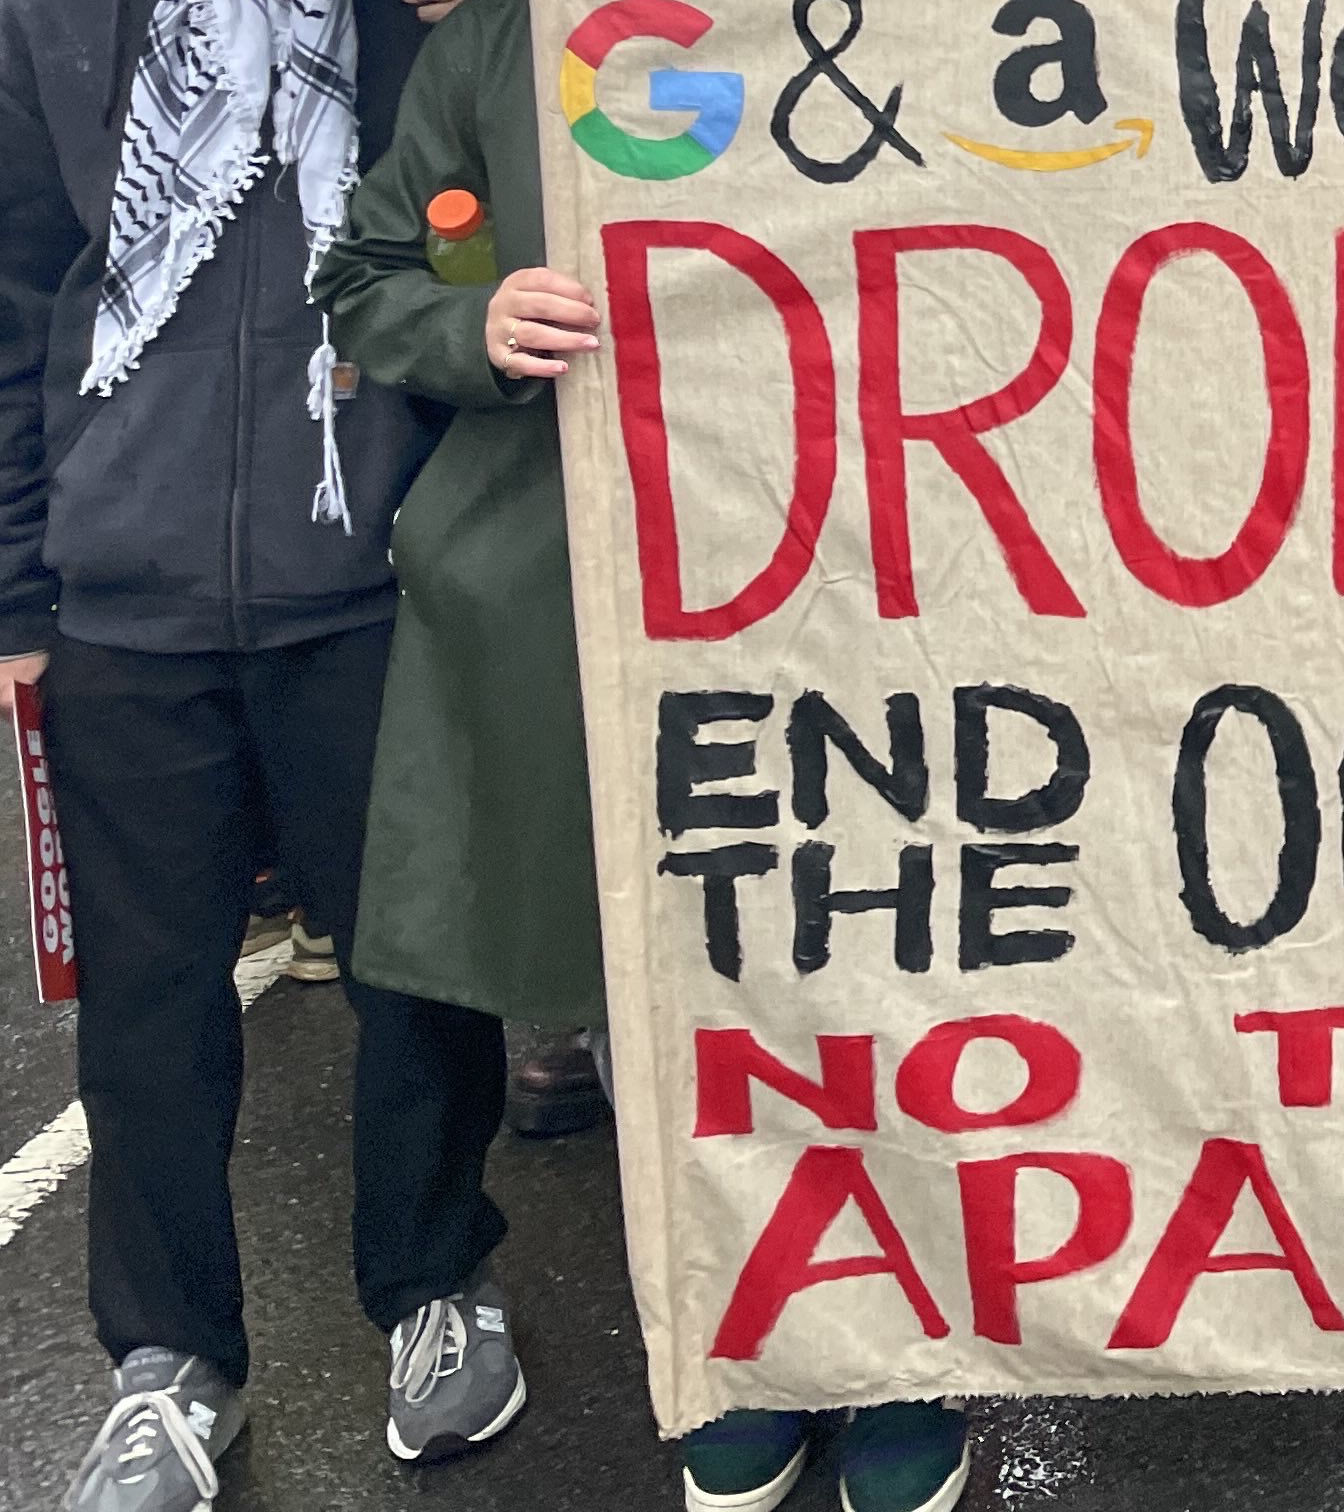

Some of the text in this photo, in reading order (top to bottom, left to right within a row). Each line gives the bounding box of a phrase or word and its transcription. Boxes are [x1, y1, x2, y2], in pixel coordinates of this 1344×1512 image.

[656, 682, 1090, 837] END
[657, 842, 1079, 982] THE
[692, 1012, 1082, 1137] NO
